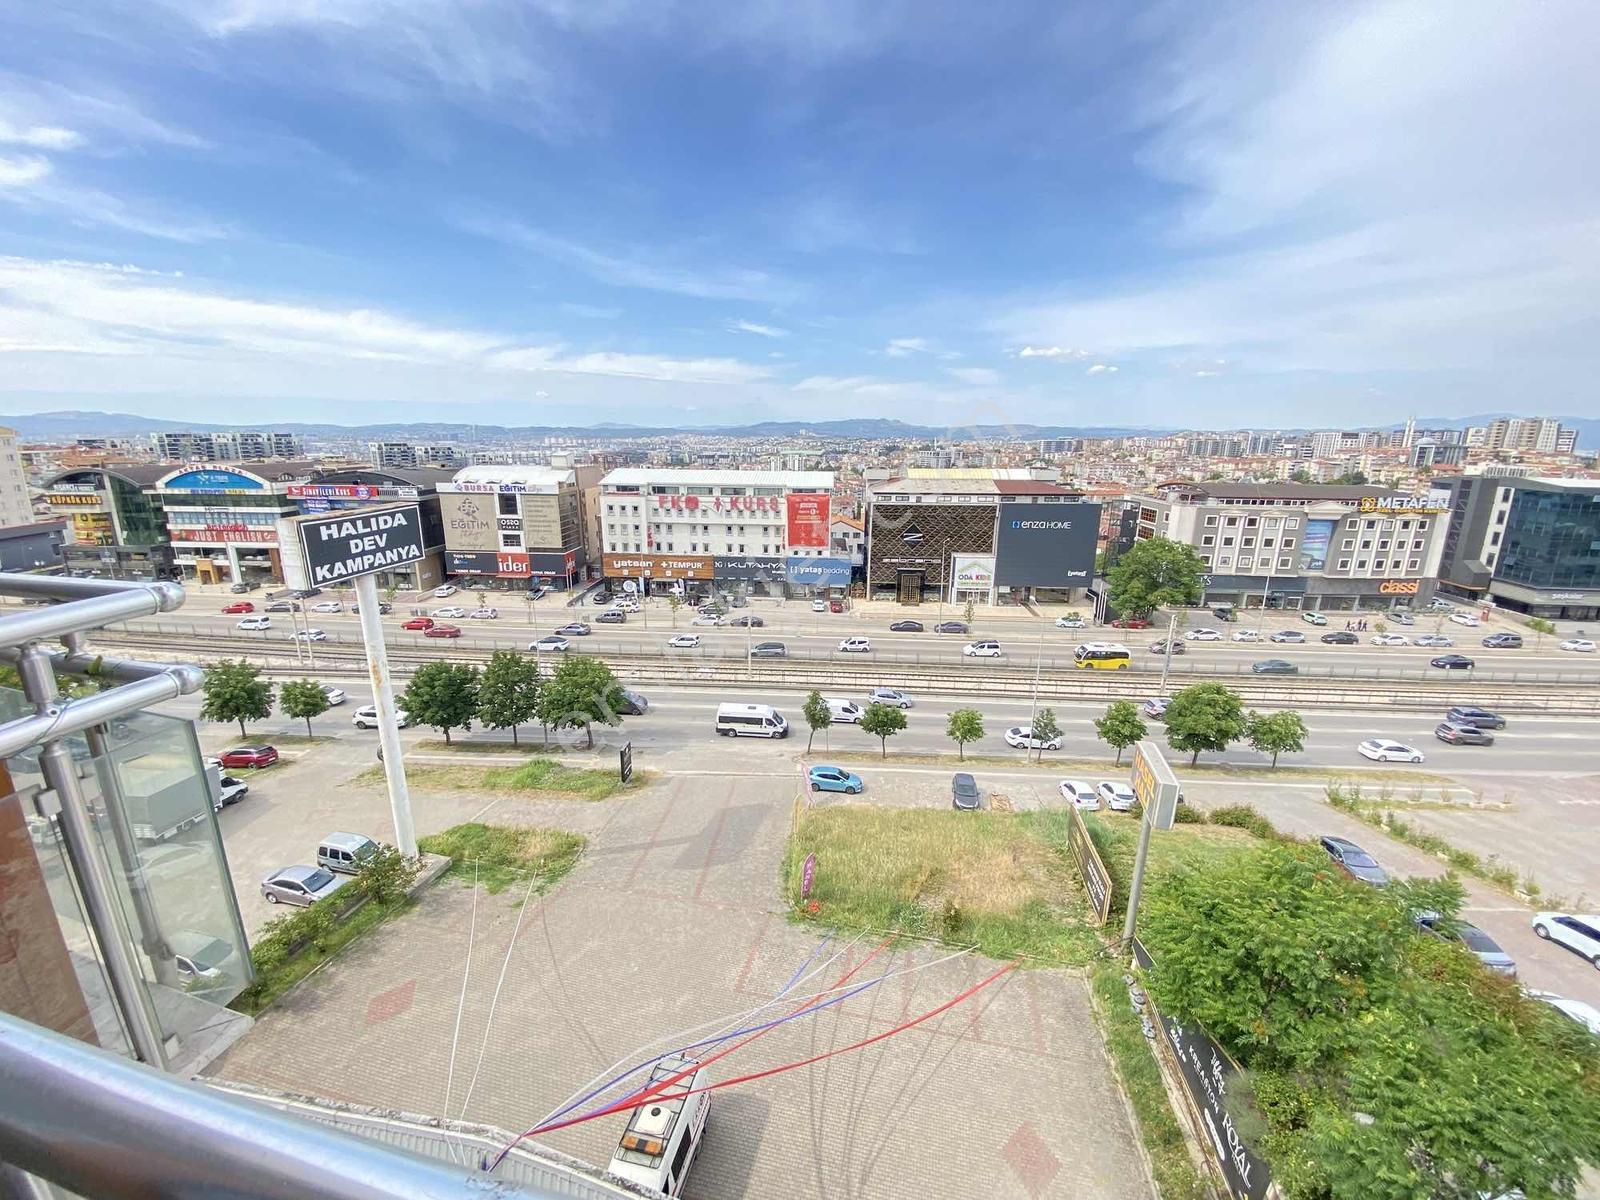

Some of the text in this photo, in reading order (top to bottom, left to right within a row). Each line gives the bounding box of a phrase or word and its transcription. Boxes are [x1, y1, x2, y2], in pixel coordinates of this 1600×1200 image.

[463, 484, 494, 492] BURSA
[499, 483, 527, 492] EĞİTİM
[730, 496, 779, 511] KURS
[1377, 497, 1450, 509] METAFEN
[319, 512, 408, 541] HALIDA
[450, 518, 490, 530] EĞİTİM
[1021, 520, 1072, 529] enza HOME
[194, 530, 263, 542] JUST ENGLISH
[349, 533, 388, 554] DEV
[315, 544, 420, 581] KAMPANYA
[498, 555, 528, 573] ider
[613, 560, 653, 568] yatsan
[669, 561, 702, 569] TEMPUR
[822, 567, 850, 575] bedding
[1379, 579, 1420, 594] classi
[1222, 1111, 1252, 1190] ROYAL
